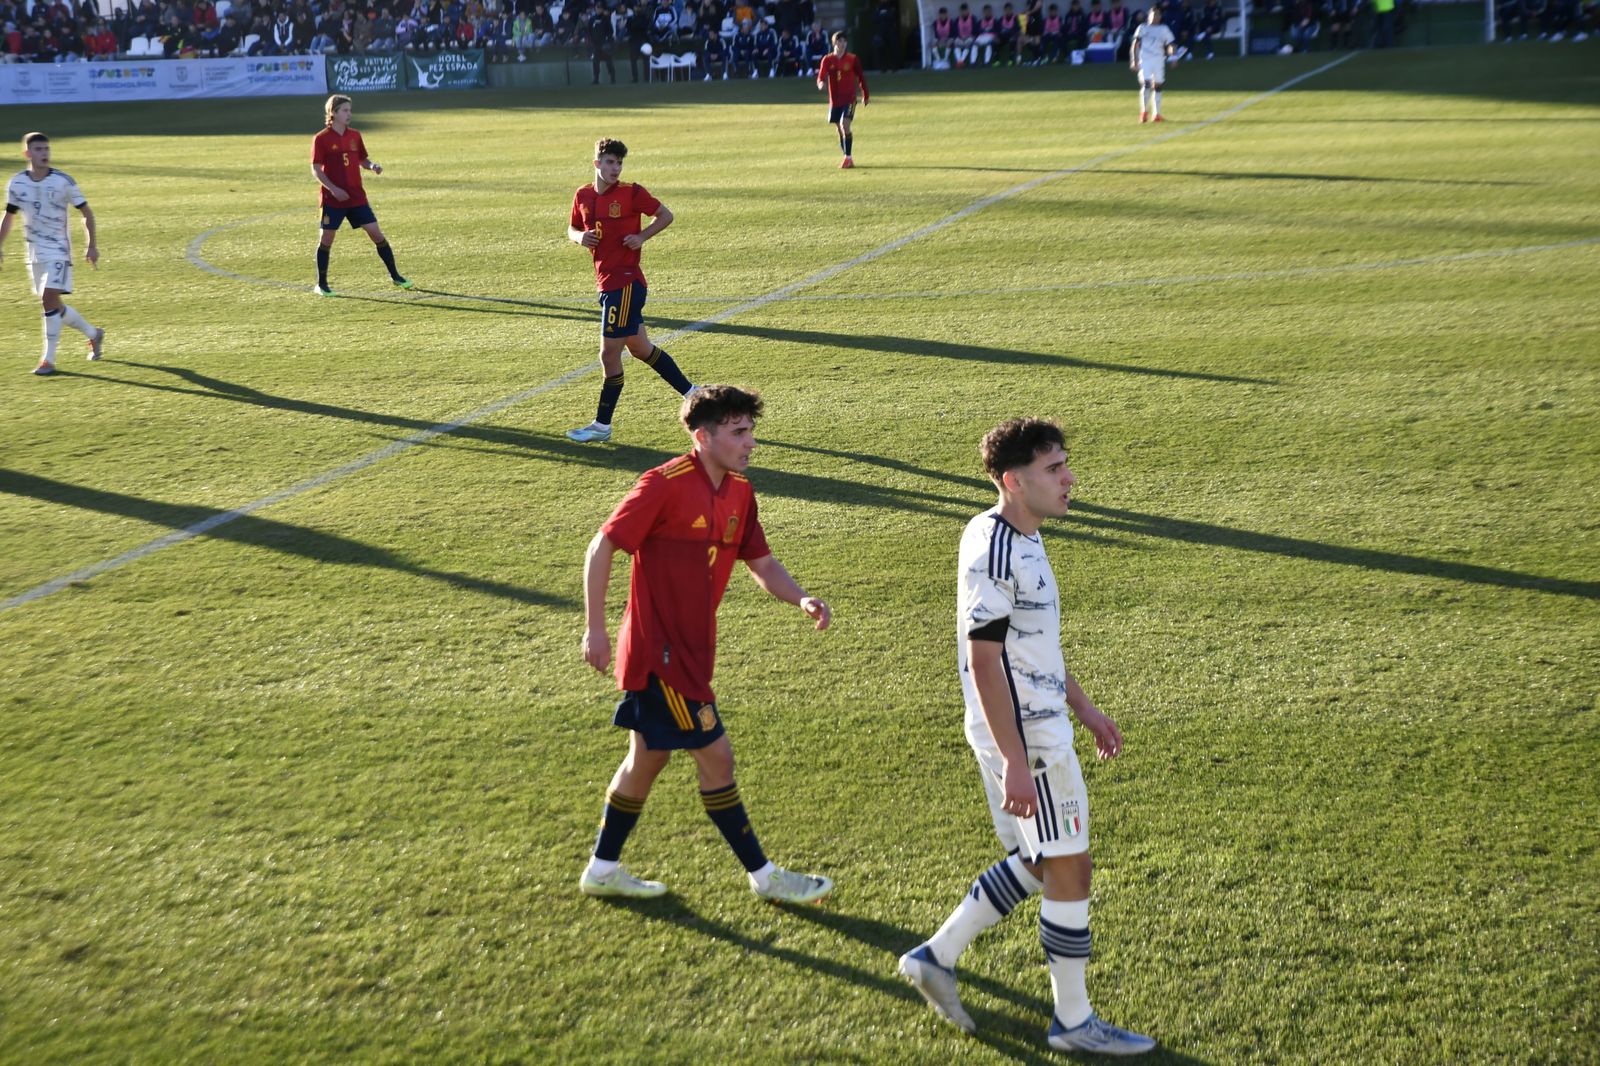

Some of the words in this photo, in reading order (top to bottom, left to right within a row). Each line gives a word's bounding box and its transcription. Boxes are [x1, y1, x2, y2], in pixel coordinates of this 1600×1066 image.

[438, 54, 467, 62] HOTEL
[428, 64, 444, 72] PEZ
[445, 62, 478, 71] ESPADA
[342, 152, 350, 166] 5
[33, 201, 41, 215] 9
[595, 221, 603, 240] 6
[55, 262, 63, 275] 9
[607, 306, 616, 324] 6
